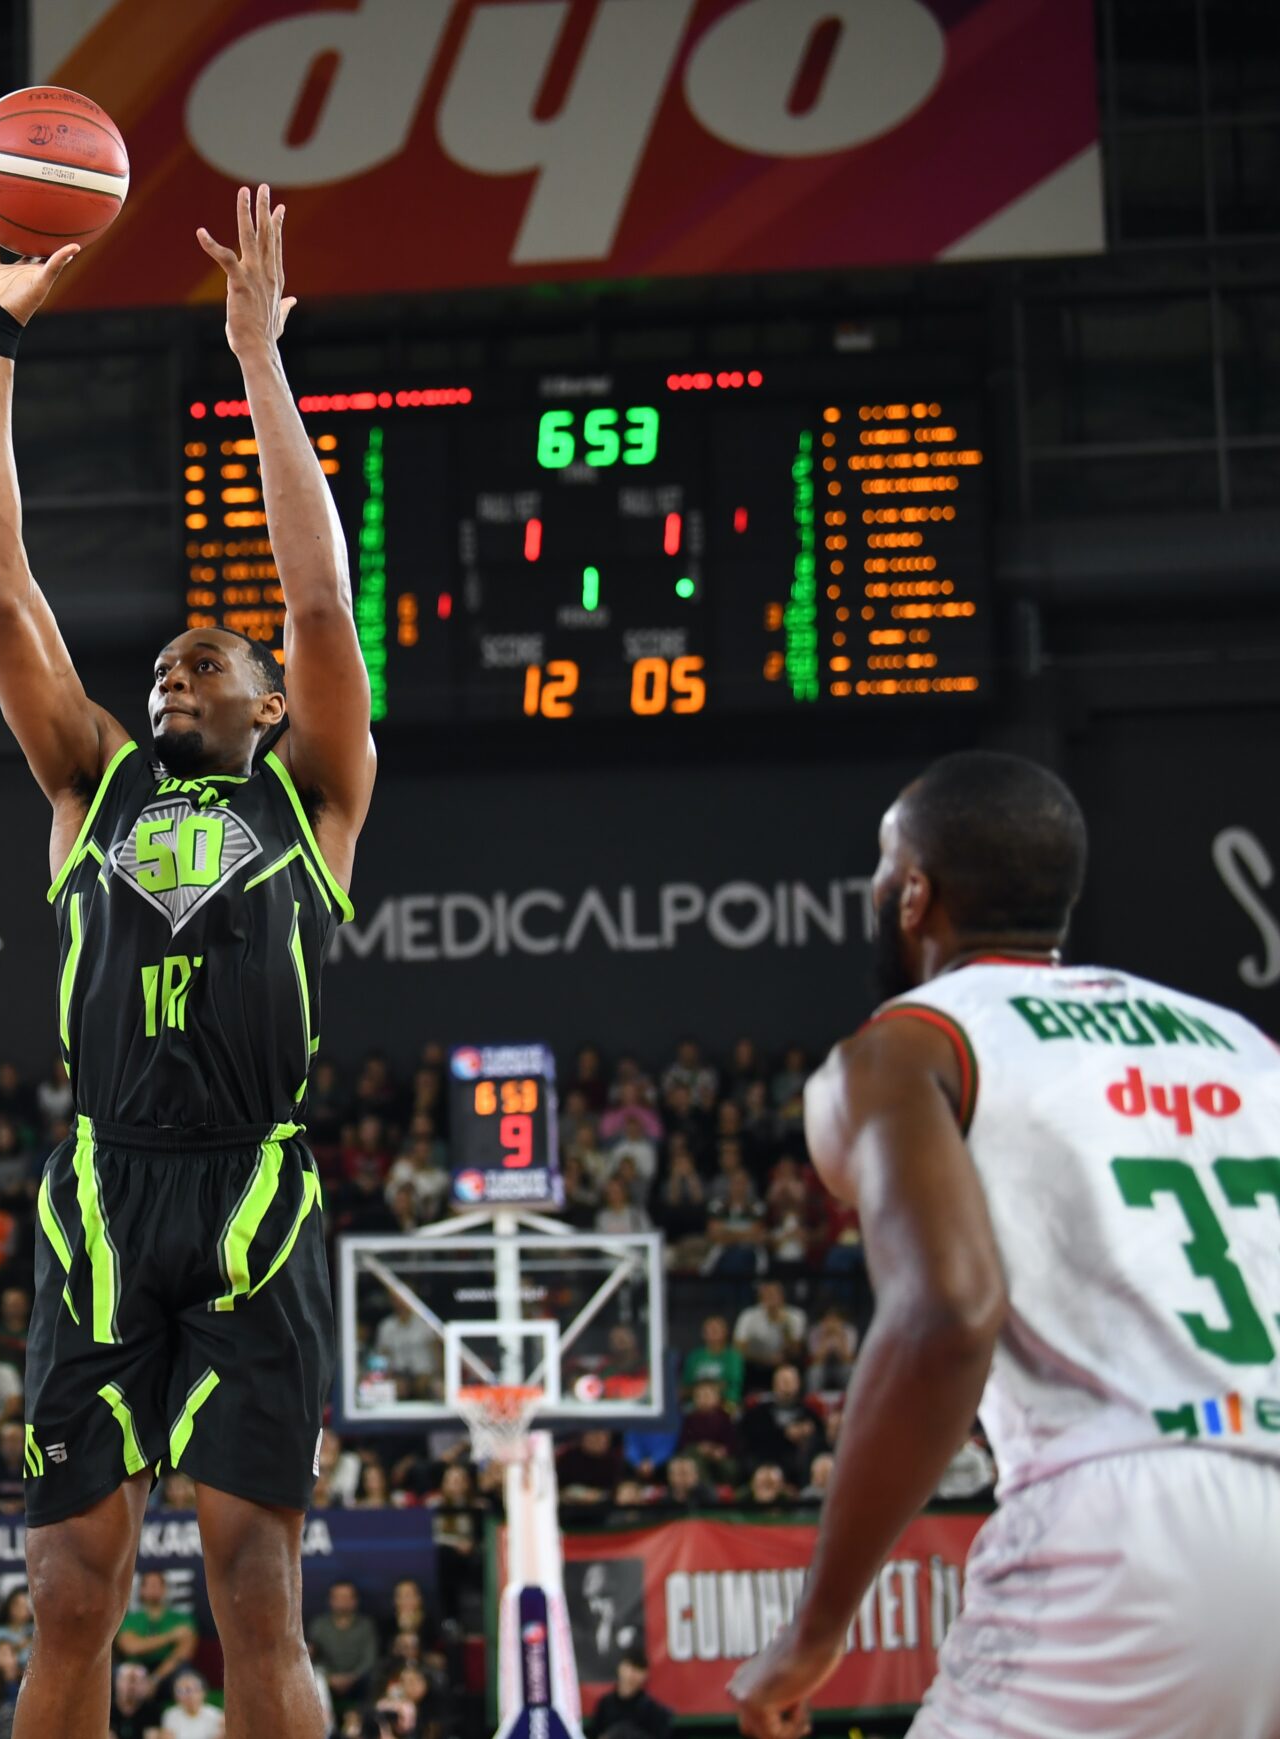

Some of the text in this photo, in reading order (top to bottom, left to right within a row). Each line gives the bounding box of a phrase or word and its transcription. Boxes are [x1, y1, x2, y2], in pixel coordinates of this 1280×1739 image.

[183, 0, 950, 265] dyo
[523, 659, 580, 719] 12
[630, 655, 707, 717] 05
[135, 815, 225, 894] 50
[330, 879, 875, 962] MEDICALPOINT
[1009, 996, 1238, 1053] BROWN
[1106, 1066, 1241, 1136] dyo
[499, 1113, 533, 1169] 9
